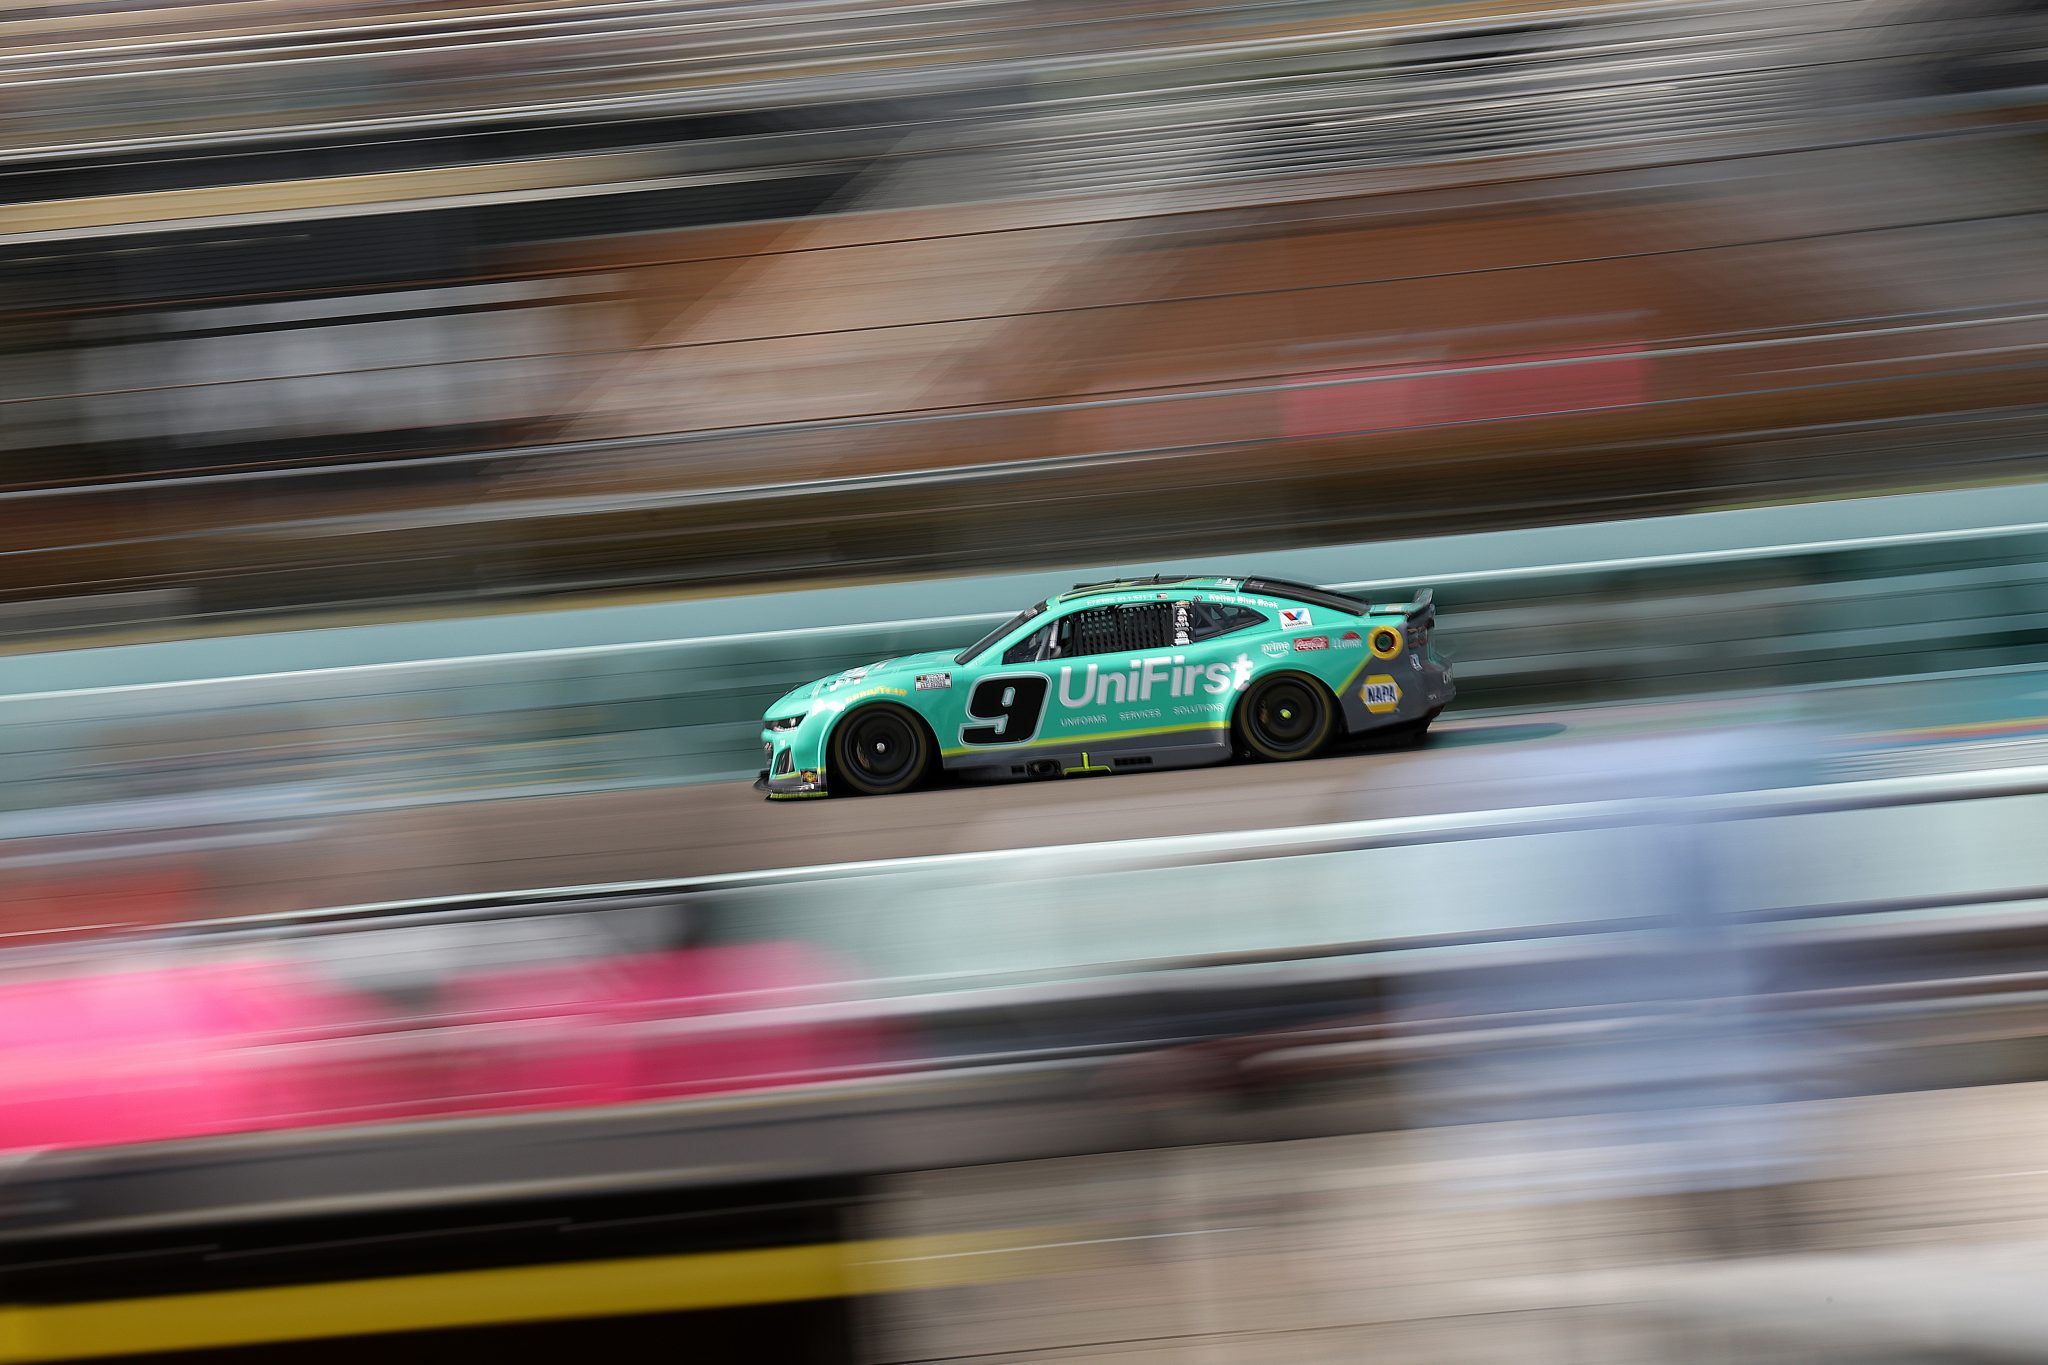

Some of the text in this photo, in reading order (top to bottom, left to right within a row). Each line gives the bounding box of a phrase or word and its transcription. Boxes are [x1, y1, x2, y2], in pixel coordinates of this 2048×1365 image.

[1059, 653, 1253, 709] UniFirst
[1366, 684, 1397, 705] NAPA
[959, 673, 1052, 748] 9
[1060, 703, 1224, 728] UNIFORMS SERVICES SOLUTIONS
